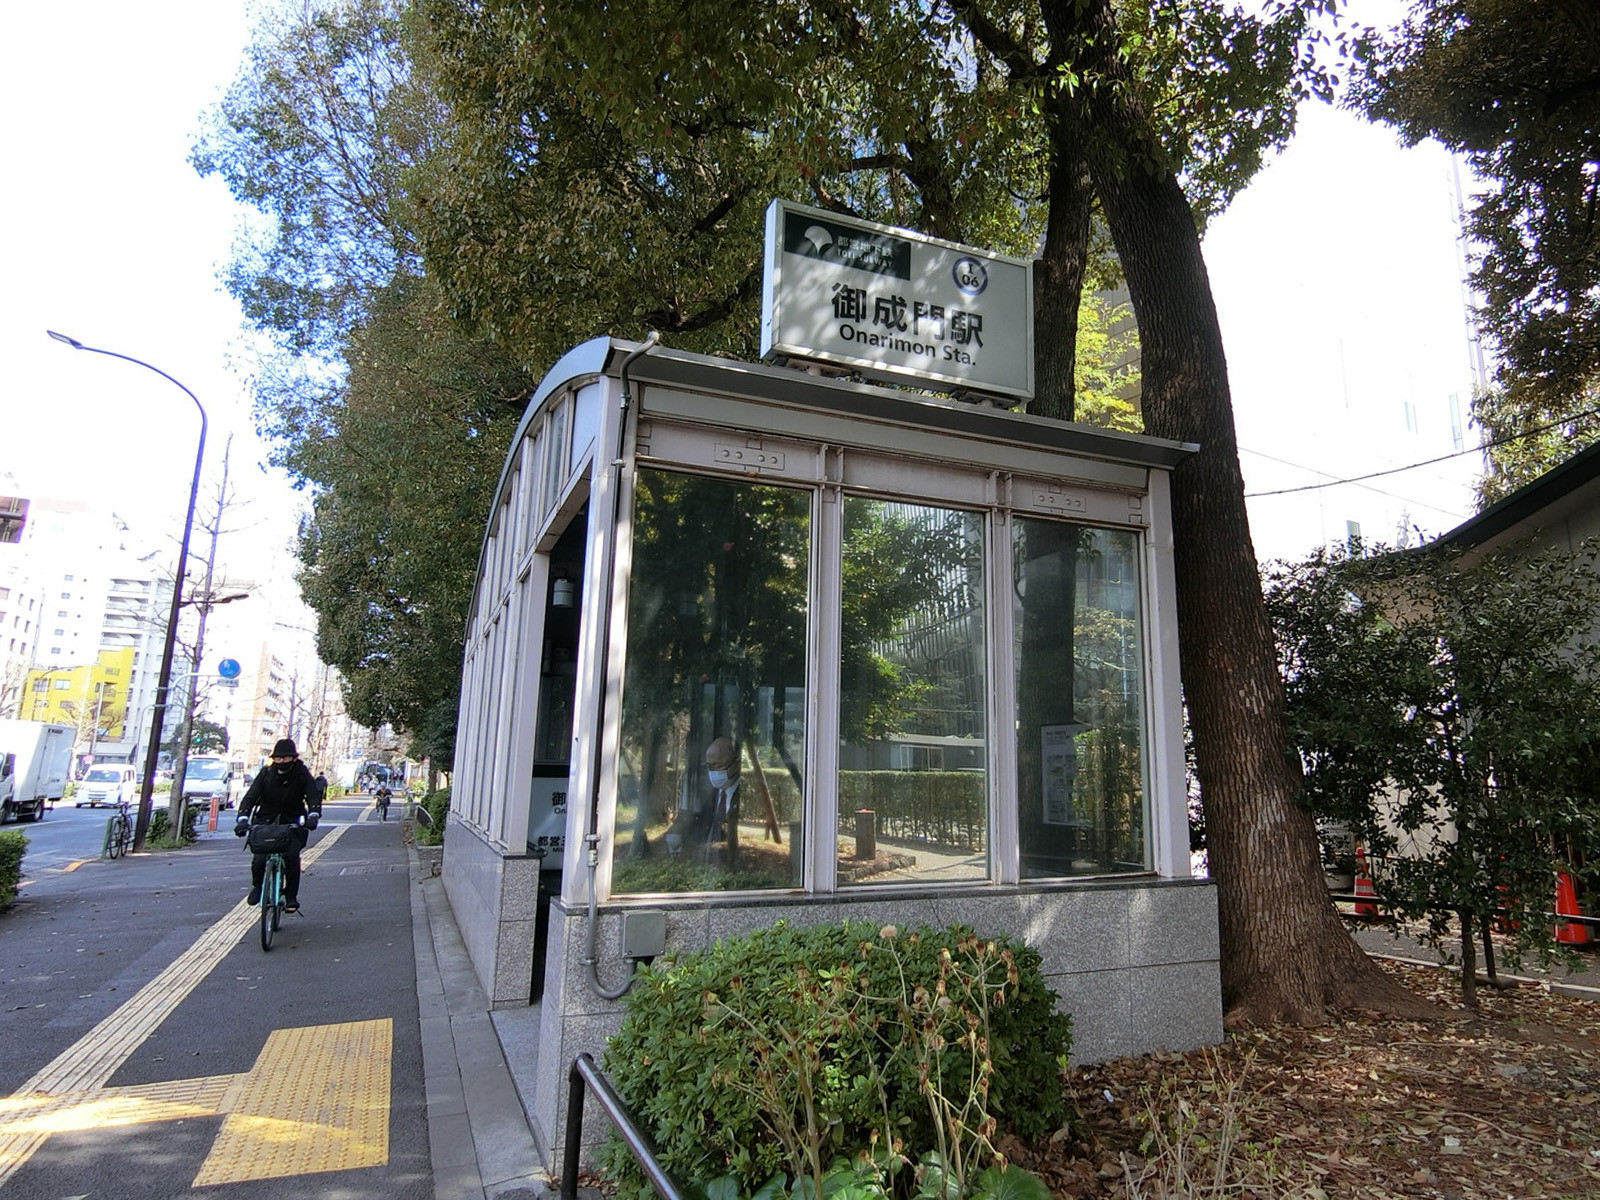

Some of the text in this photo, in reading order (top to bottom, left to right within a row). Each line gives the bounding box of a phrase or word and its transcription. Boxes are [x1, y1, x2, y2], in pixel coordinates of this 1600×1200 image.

[837, 235, 893, 258] 都営地下鉄
[837, 248, 893, 268] TOEI SUBWAY
[961, 274, 980, 288] 06
[831, 282, 984, 349] 御成門駅
[839, 323, 977, 366] Onarimon Sta.
